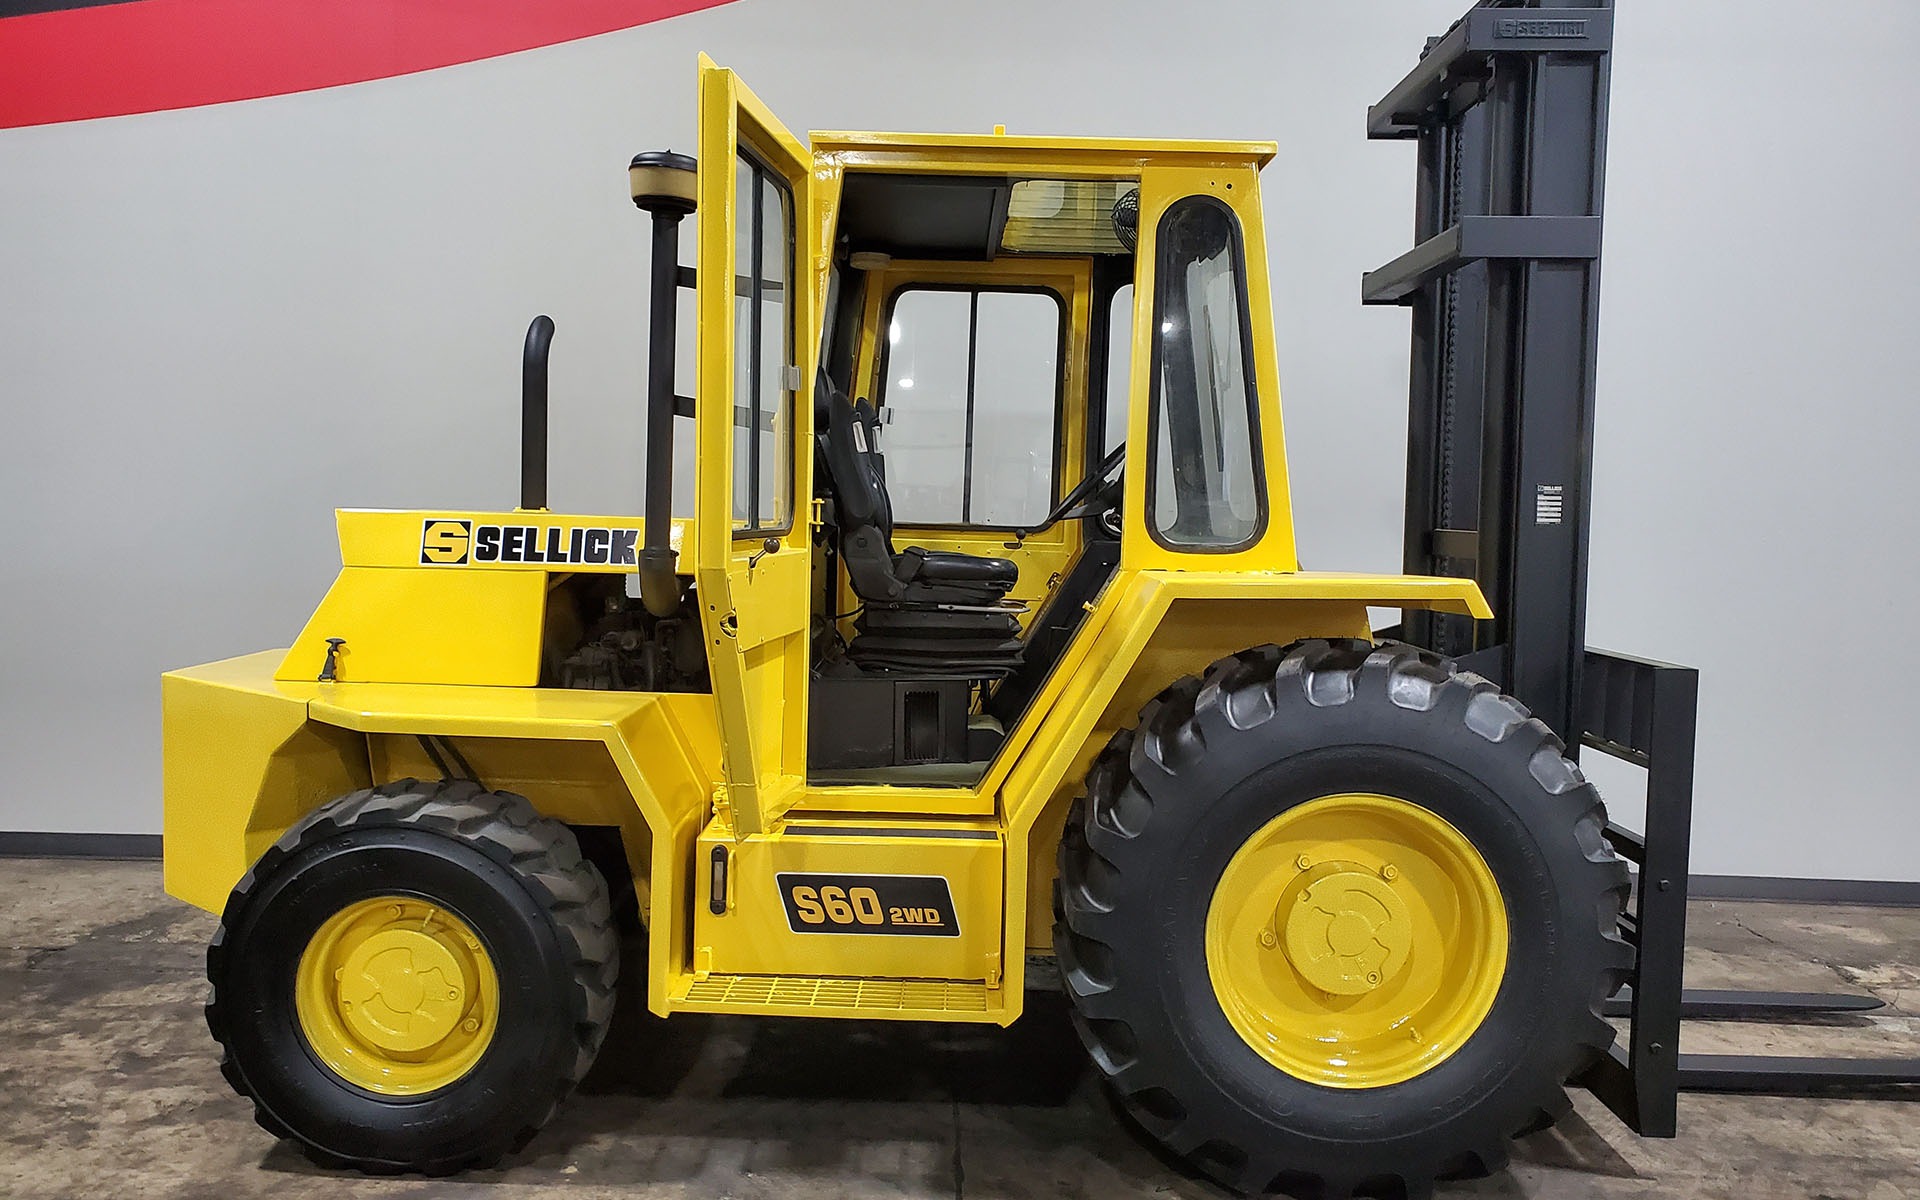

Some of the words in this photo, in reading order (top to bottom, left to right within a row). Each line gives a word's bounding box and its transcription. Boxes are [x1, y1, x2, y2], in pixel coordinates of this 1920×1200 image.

[423, 521, 470, 563] S
[474, 525, 639, 565] SELLICK
[791, 885, 884, 925] S60
[888, 907, 941, 924] 2WD
